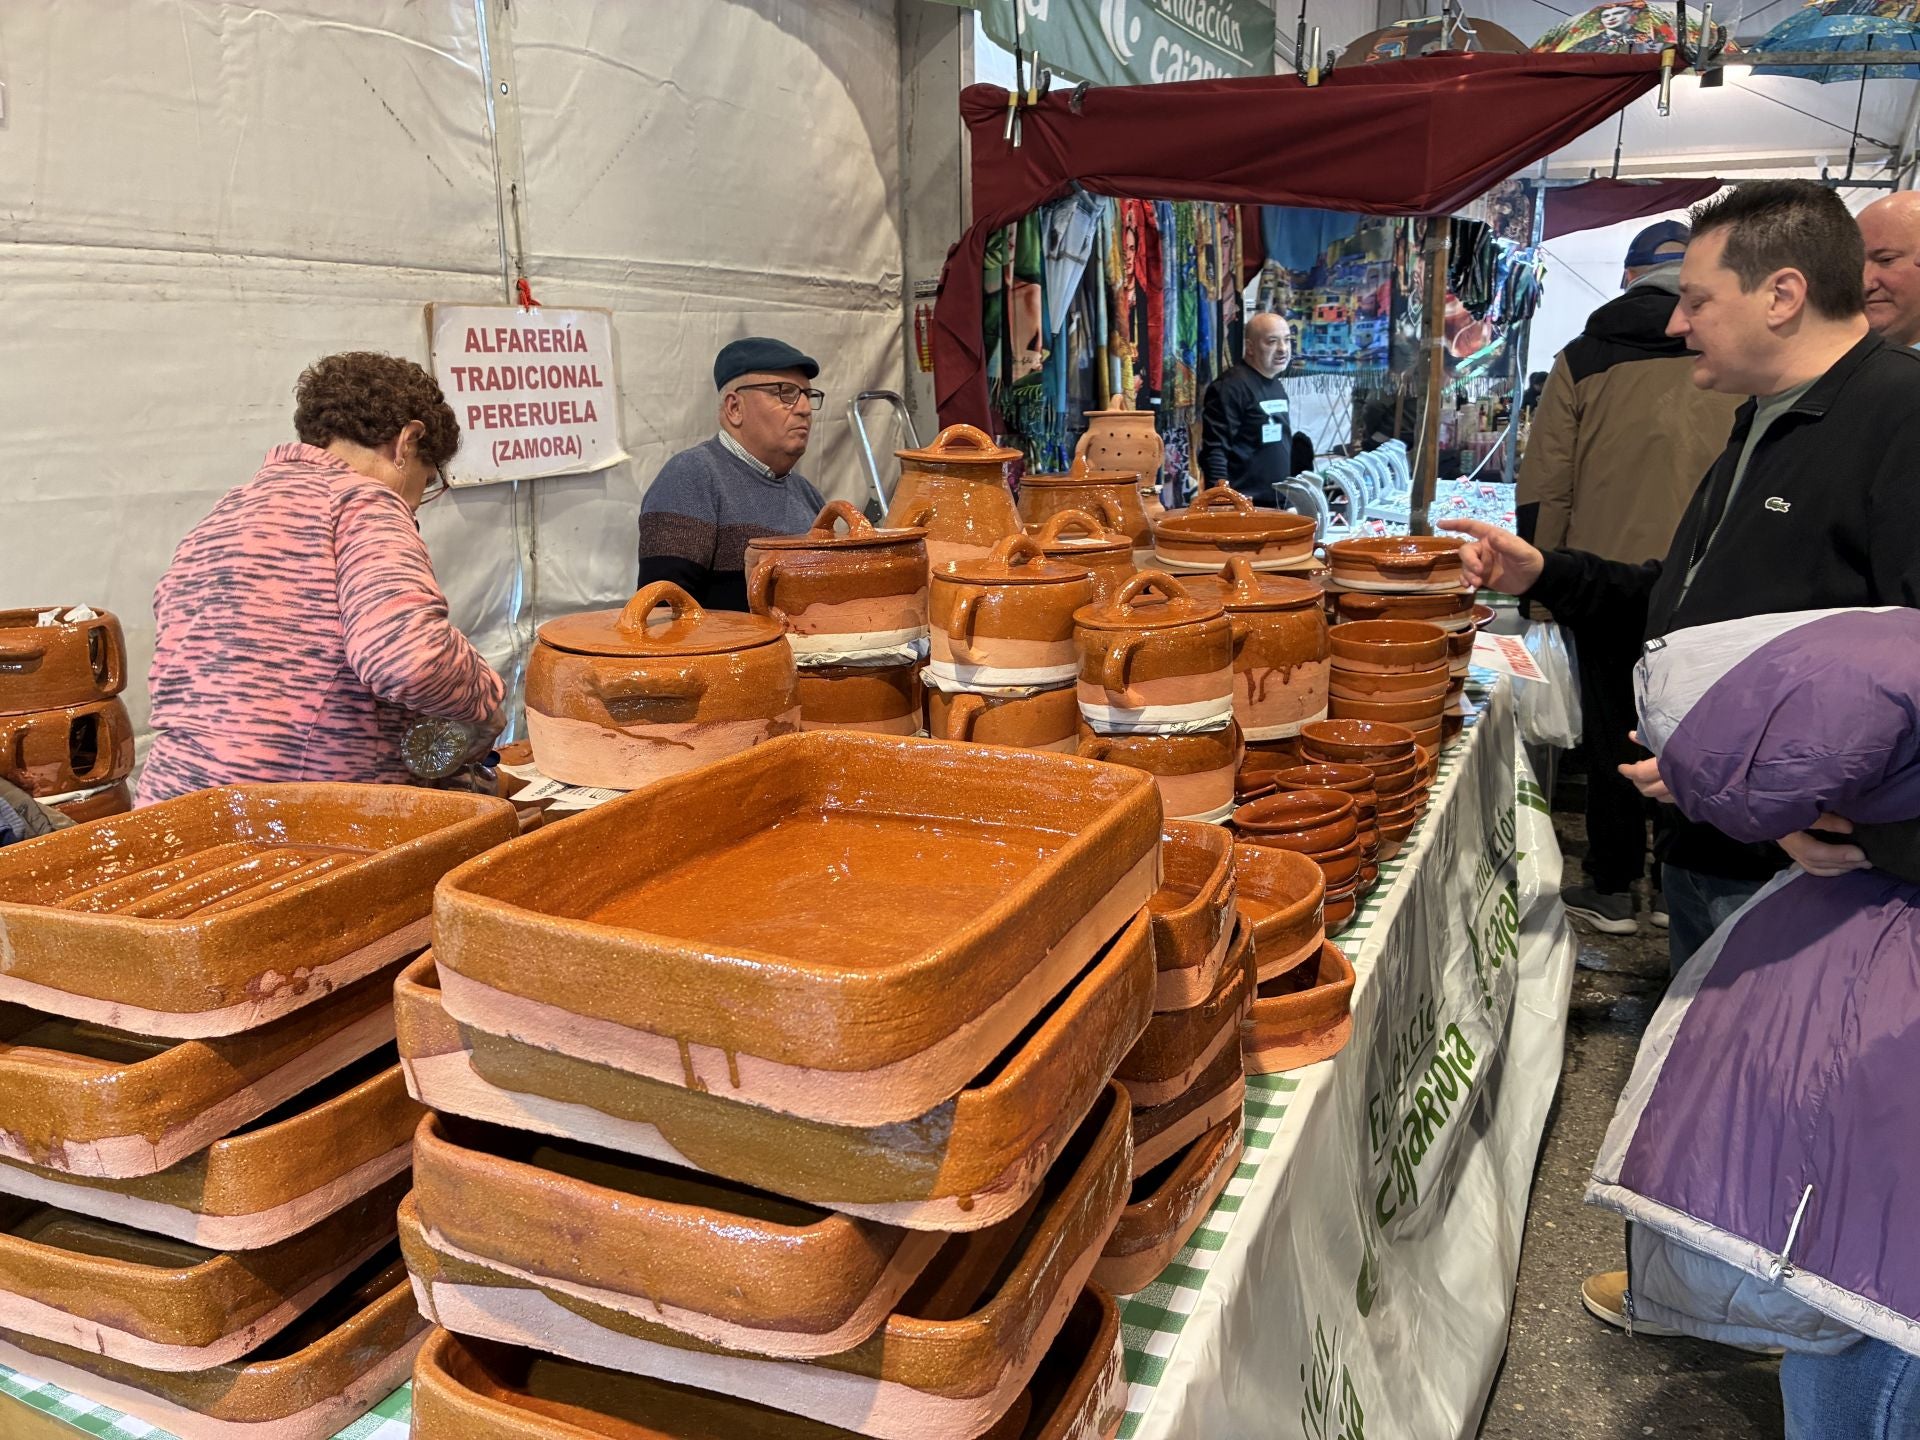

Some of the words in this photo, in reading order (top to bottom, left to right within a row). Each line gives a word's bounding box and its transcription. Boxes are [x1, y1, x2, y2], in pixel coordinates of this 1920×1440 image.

[464, 323, 588, 353] ALFARERÍA
[450, 365, 604, 392] TRADICIONAL
[466, 400, 598, 430] PERERUELA
[492, 435, 583, 467] (ZAMORA)
